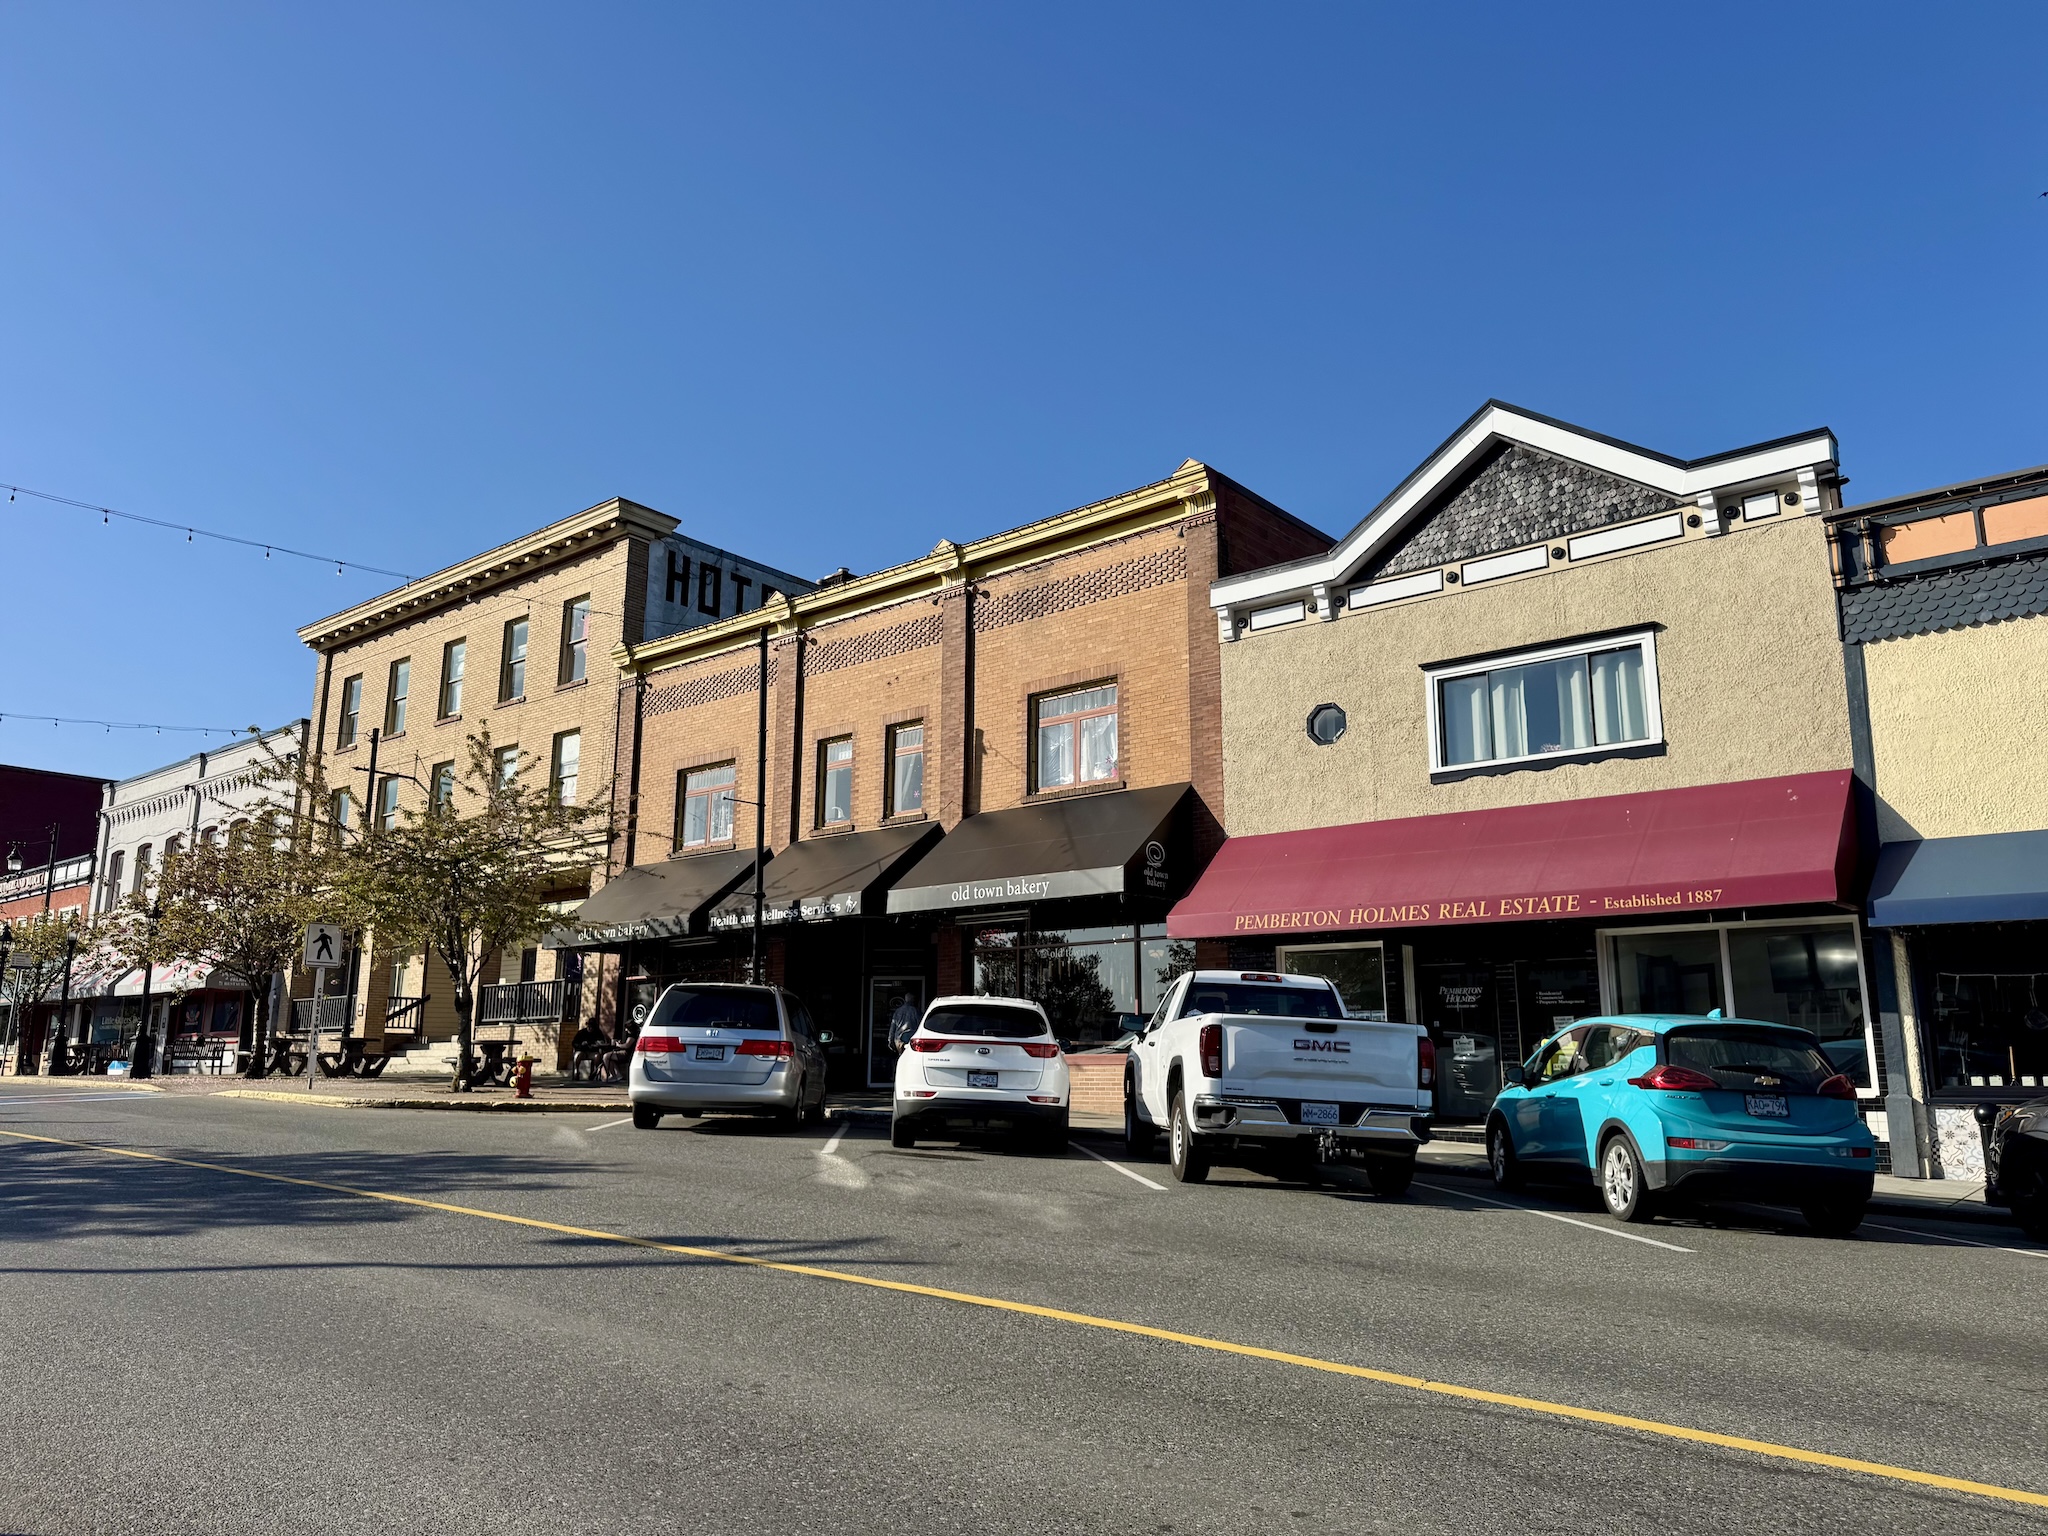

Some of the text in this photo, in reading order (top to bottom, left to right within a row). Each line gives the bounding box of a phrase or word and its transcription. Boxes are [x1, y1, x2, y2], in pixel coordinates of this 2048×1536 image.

[1143, 867, 1169, 880] old town
[951, 879, 1050, 902] old town bakery
[1146, 877, 1166, 889] bakery
[710, 914, 739, 928] Health
[801, 902, 841, 917] Services
[1234, 909, 1342, 931] PEMBERTON
[1348, 903, 1430, 925] HOLMES
[1438, 899, 1491, 920] REAL
[1499, 894, 1581, 916] ESTATE
[1603, 890, 1682, 910] Established
[1686, 889, 1723, 904] 1887
[578, 927, 592, 942] old
[617, 922, 650, 939] bakery
[1438, 986, 1484, 995] PEMBERTON
[1445, 994, 1478, 1003] HOLMES
[311, 987, 322, 1051] CROSSWALK
[1292, 1039, 1351, 1053] GMC
